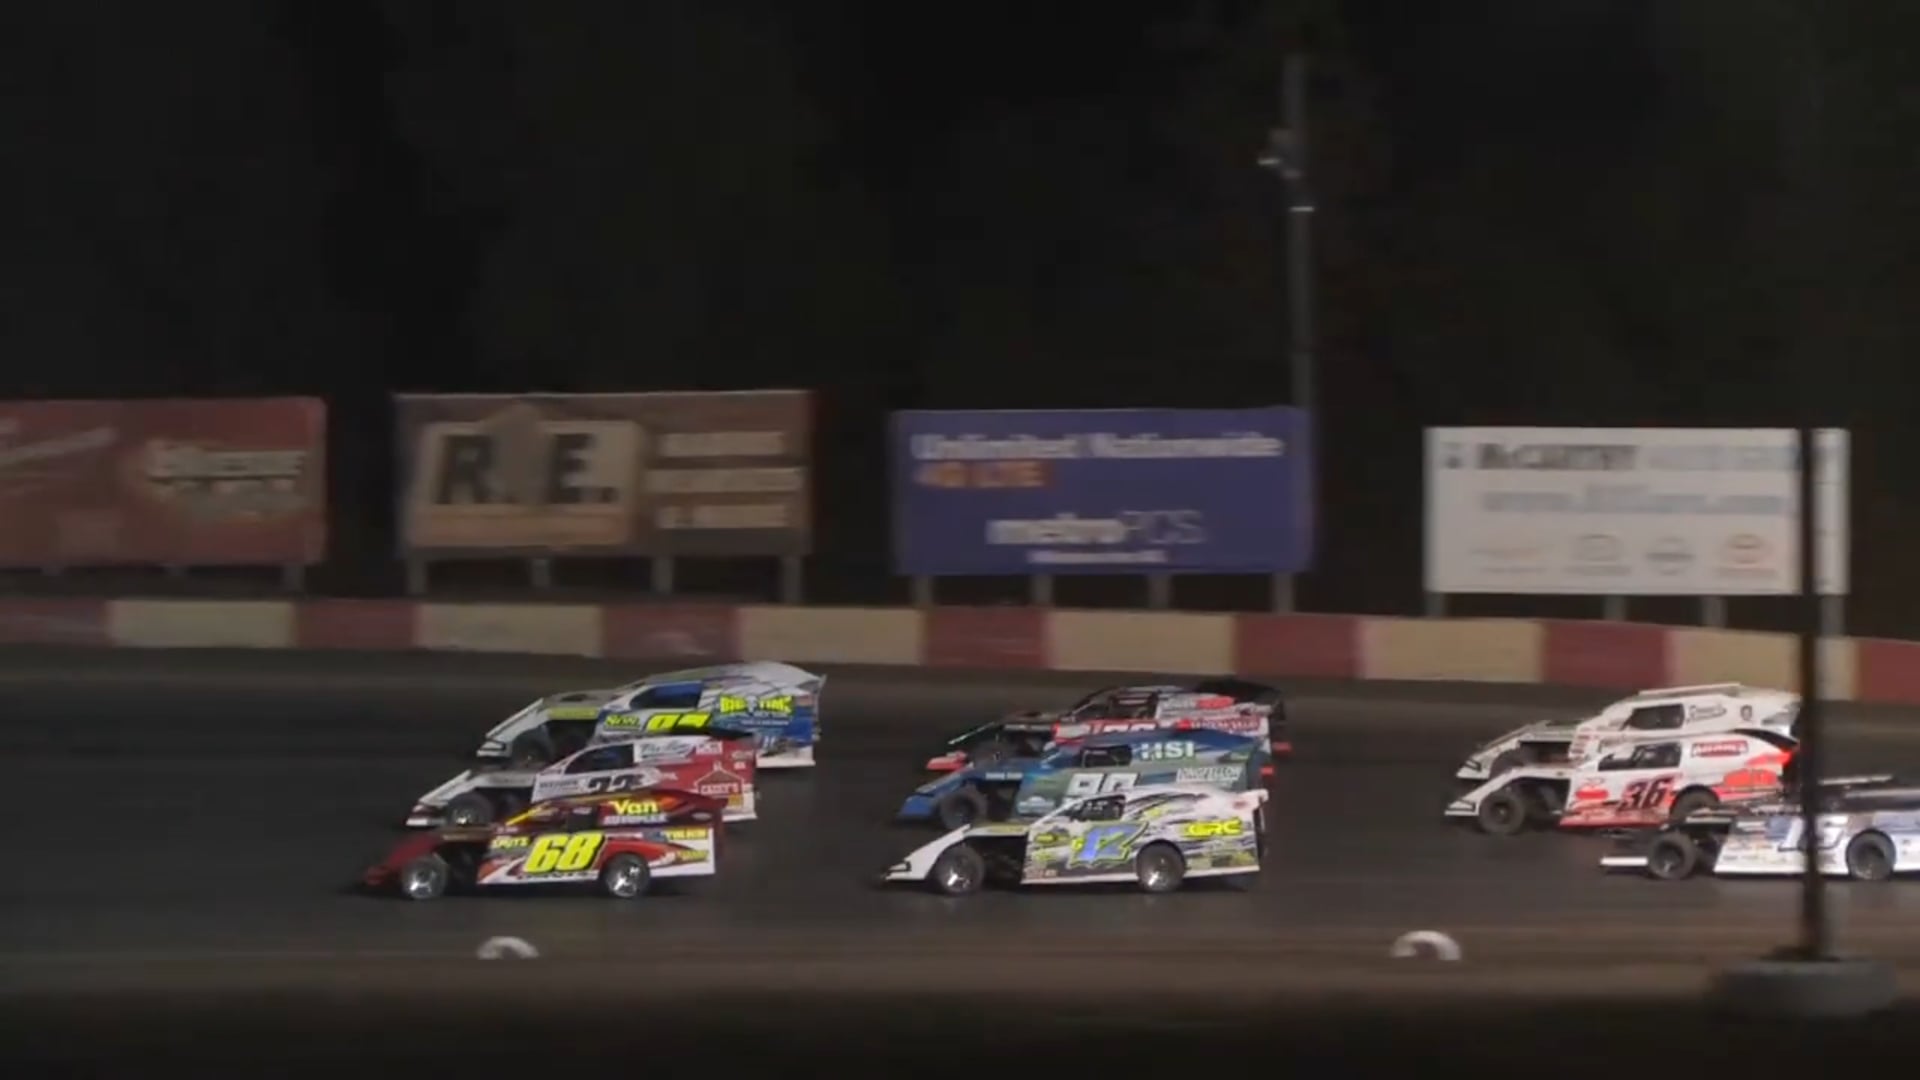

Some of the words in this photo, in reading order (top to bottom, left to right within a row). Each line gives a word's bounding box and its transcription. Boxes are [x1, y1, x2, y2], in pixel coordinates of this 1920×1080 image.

[985, 510, 1206, 545] metroPCS
[1140, 741, 1195, 760] HSI
[608, 799, 659, 815] Van
[1617, 774, 1677, 813] 36
[522, 831, 604, 874] 68
